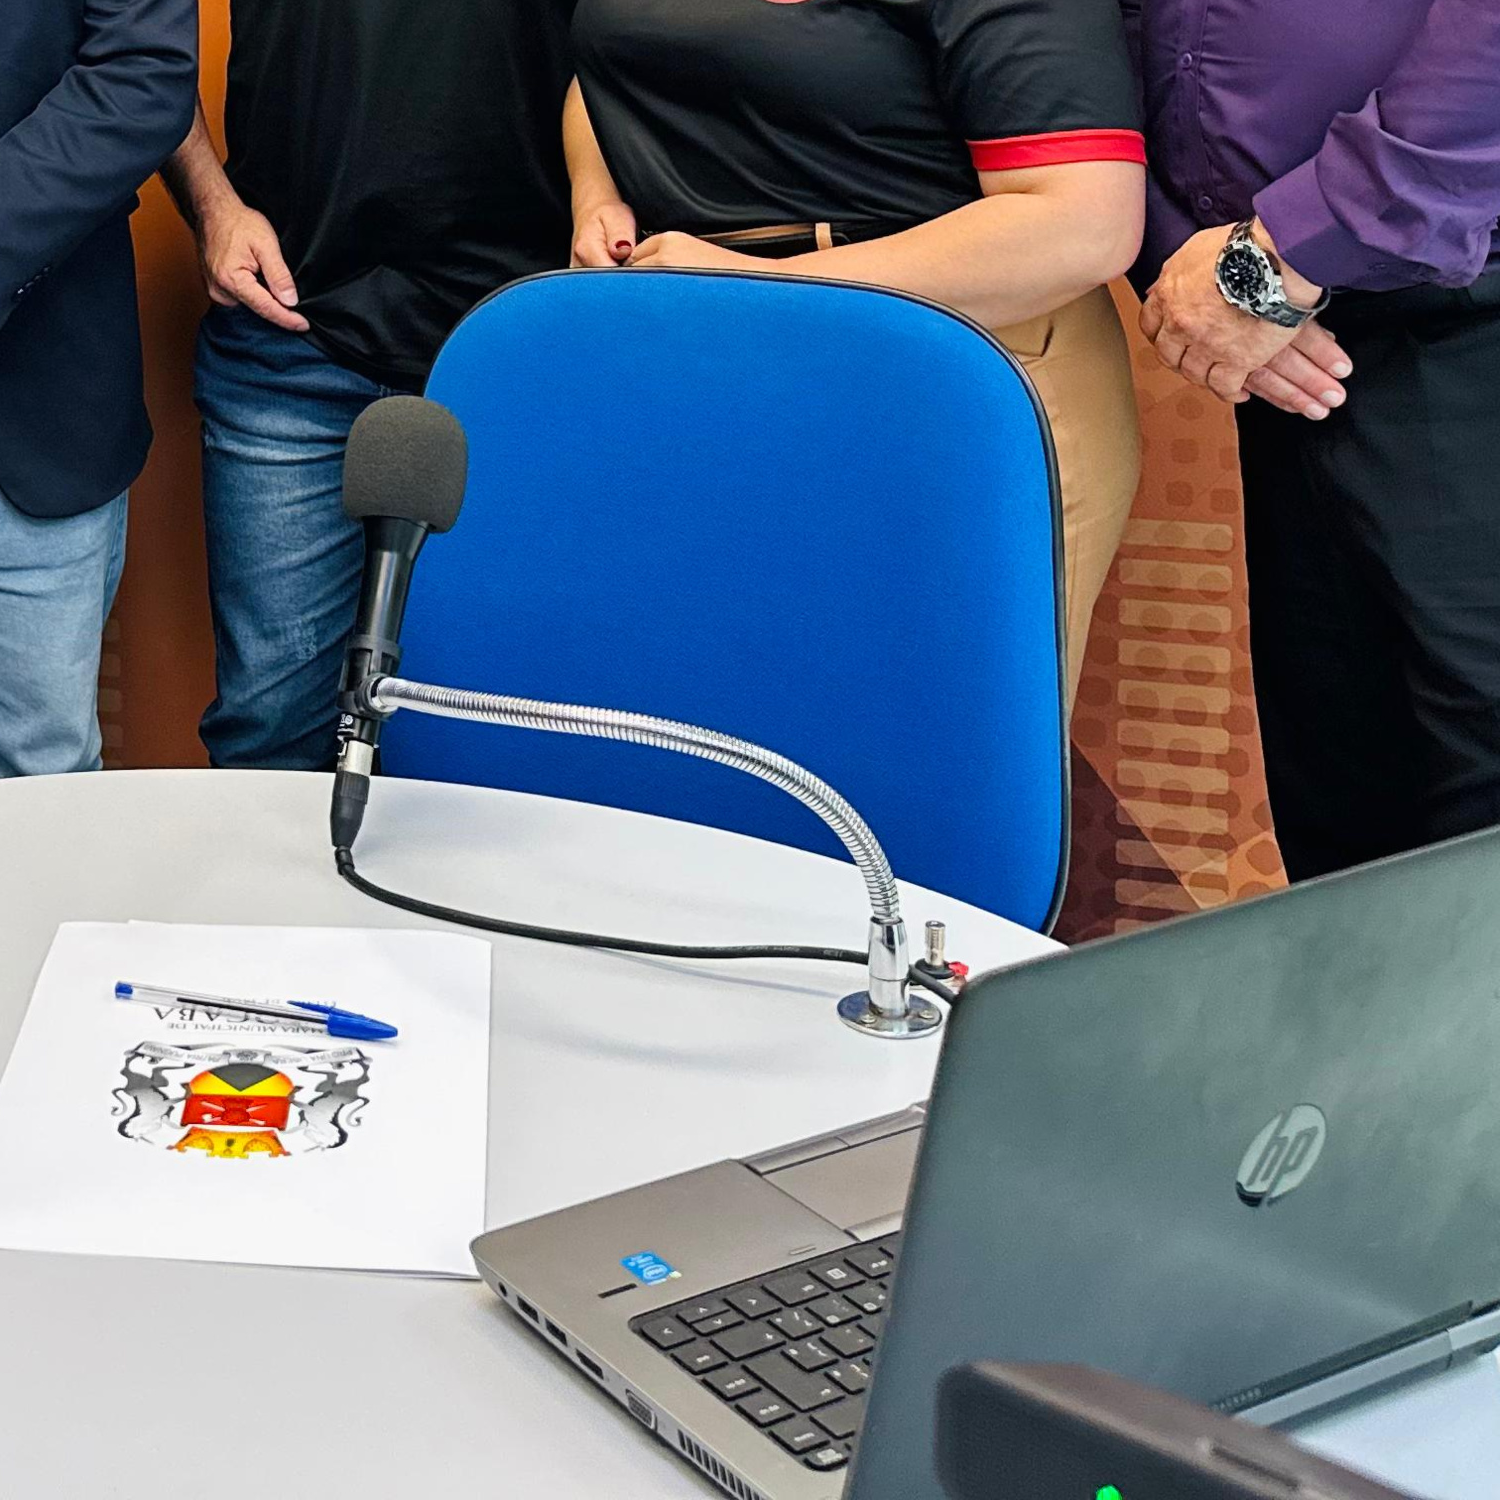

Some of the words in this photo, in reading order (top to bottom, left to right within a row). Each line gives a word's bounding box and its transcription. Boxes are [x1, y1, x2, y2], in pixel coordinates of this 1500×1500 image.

[167, 1022, 188, 1030] DE
[194, 1023, 277, 1034] MUNICIPAL
[281, 1024, 325, 1035] MARA
[1246, 1109, 1319, 1199] hp
